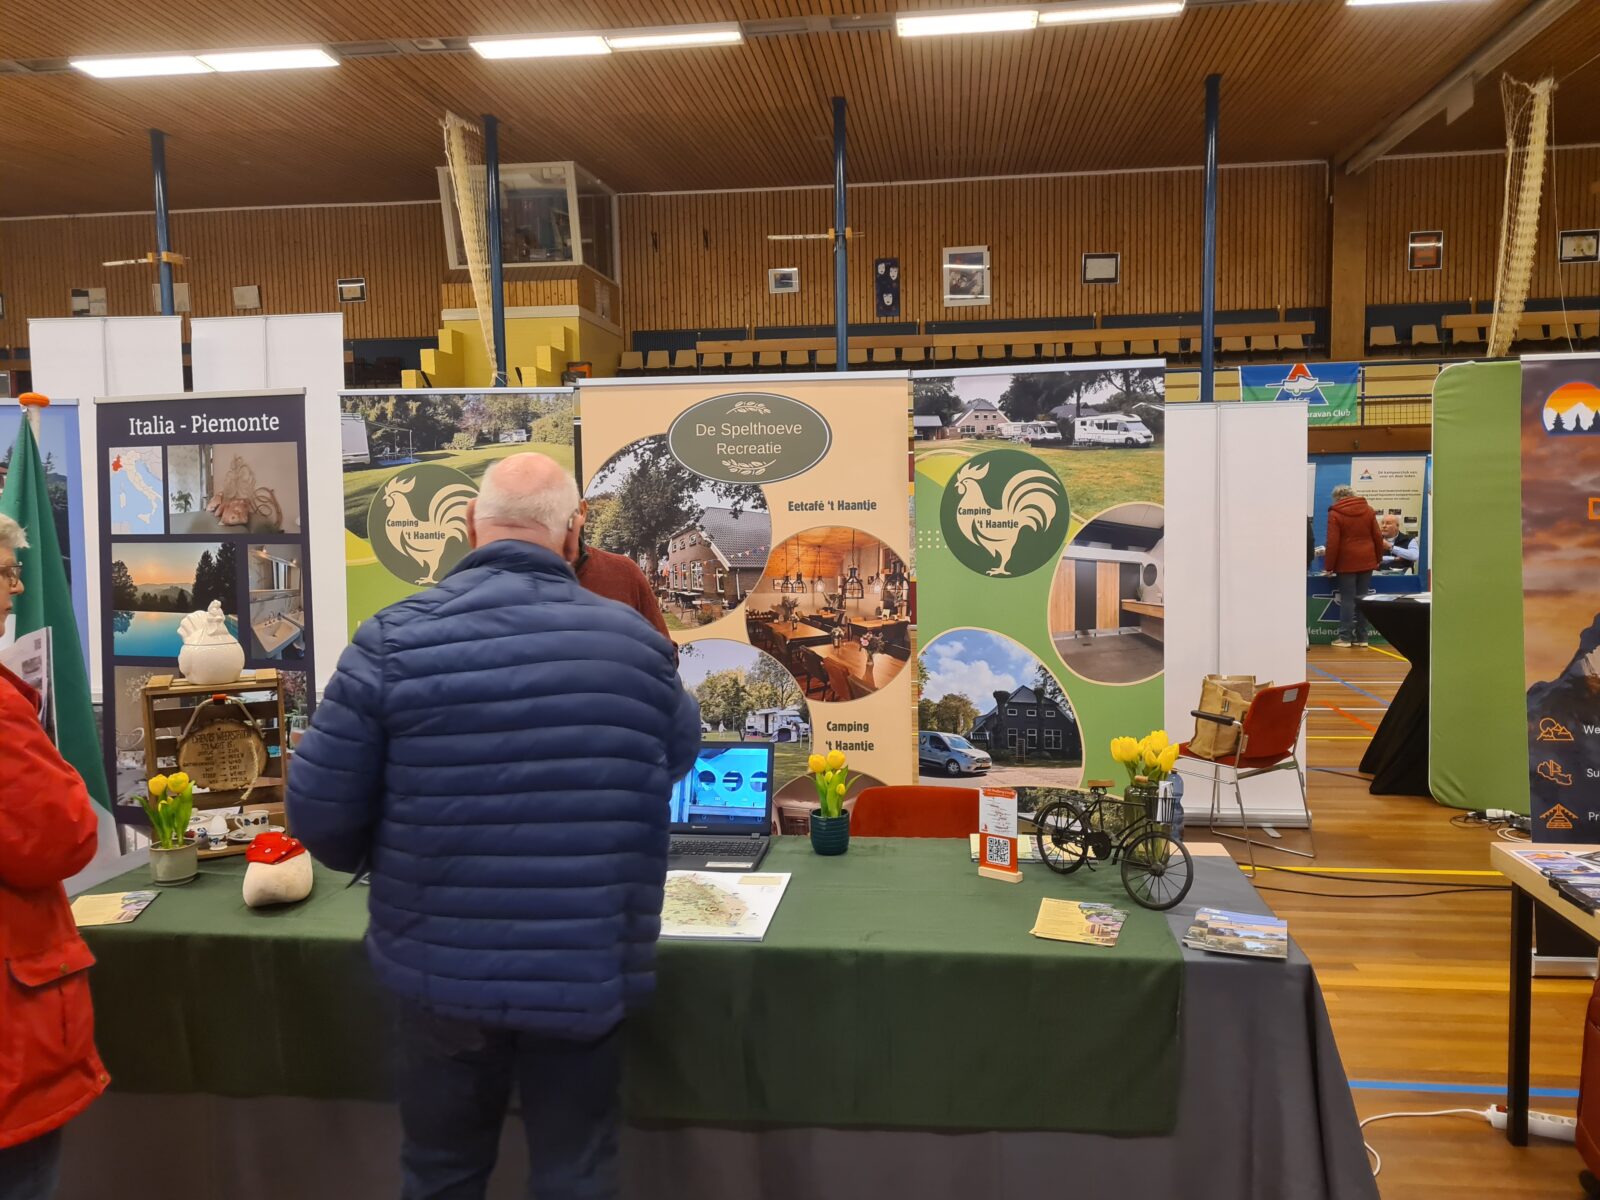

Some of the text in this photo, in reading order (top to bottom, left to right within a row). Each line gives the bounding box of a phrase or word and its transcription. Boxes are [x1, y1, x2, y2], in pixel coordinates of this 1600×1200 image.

[1333, 409, 1351, 417] Club
[128, 415, 176, 436] Italia
[191, 413, 280, 434] Piemonte
[695, 422, 803, 439] De Spelthoeve
[716, 441, 782, 455] Recreatie
[788, 500, 825, 512] Eetcafé
[837, 499, 877, 512] Haantje
[958, 507, 992, 516] Camping
[386, 519, 419, 528] Camping
[985, 519, 1019, 529] Haantje
[413, 530, 446, 540] Haantje
[826, 721, 869, 732] Camping
[835, 740, 874, 751] Haantje
